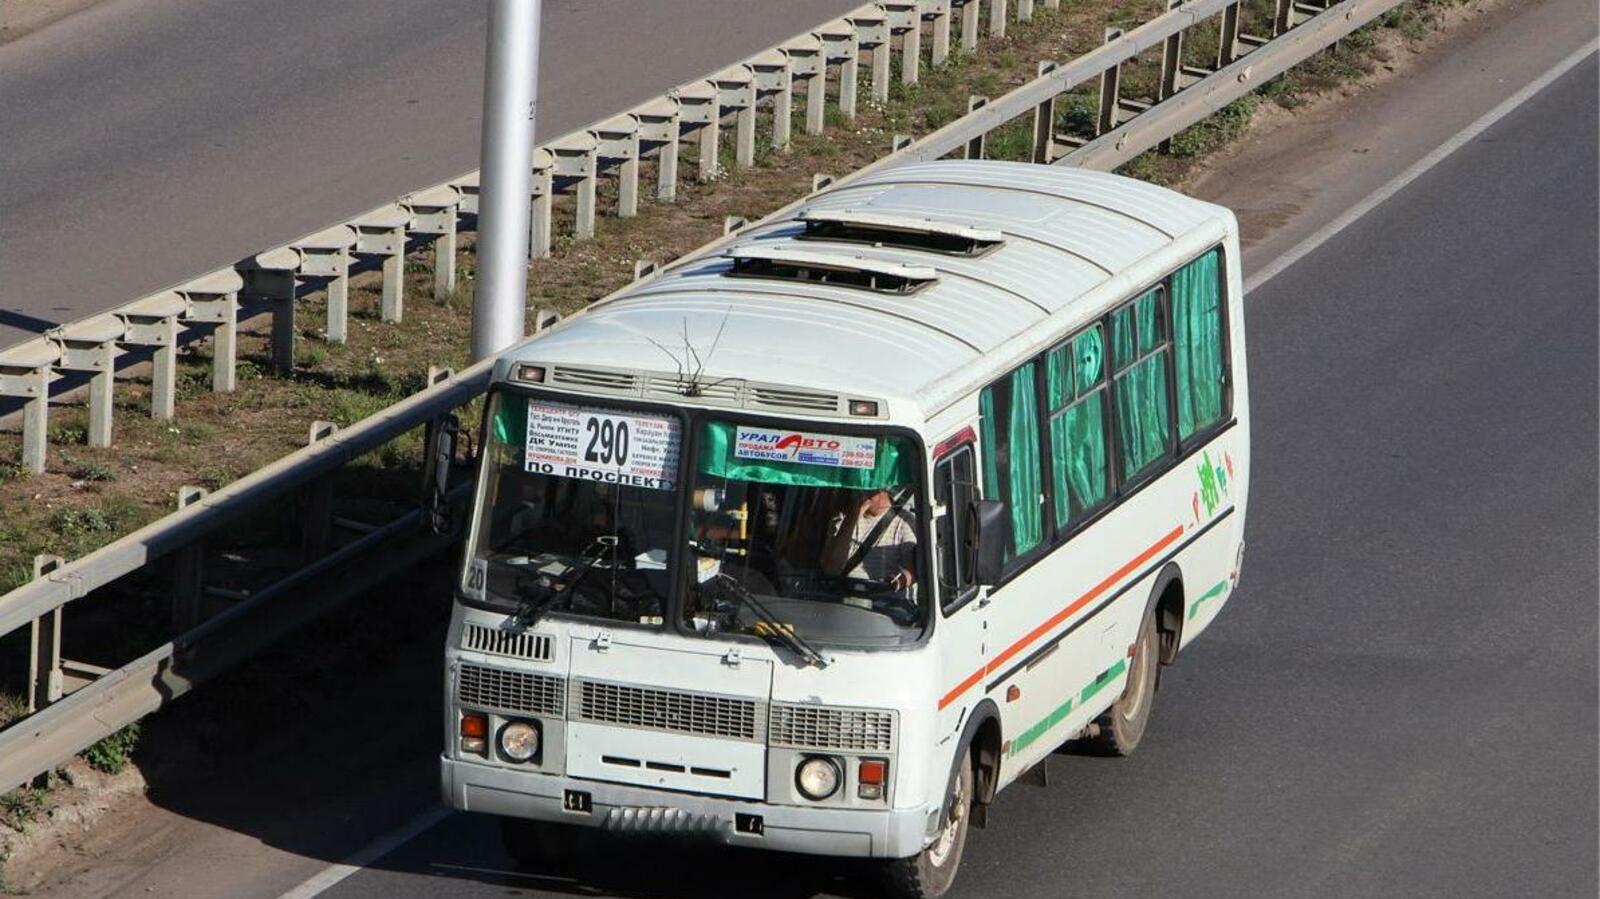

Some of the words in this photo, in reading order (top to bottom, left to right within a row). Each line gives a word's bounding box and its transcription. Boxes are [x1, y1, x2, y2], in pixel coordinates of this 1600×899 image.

[529, 437, 545, 446] ДК
[584, 416, 629, 466] 290
[740, 432, 781, 443] УРАЛ
[739, 443, 774, 451] ПРОДАЖА
[737, 449, 788, 460] АВТОБУСОВ
[528, 461, 554, 474] ПО
[566, 466, 674, 489] ПРОСПЕКТУ
[468, 566, 484, 590] 20
